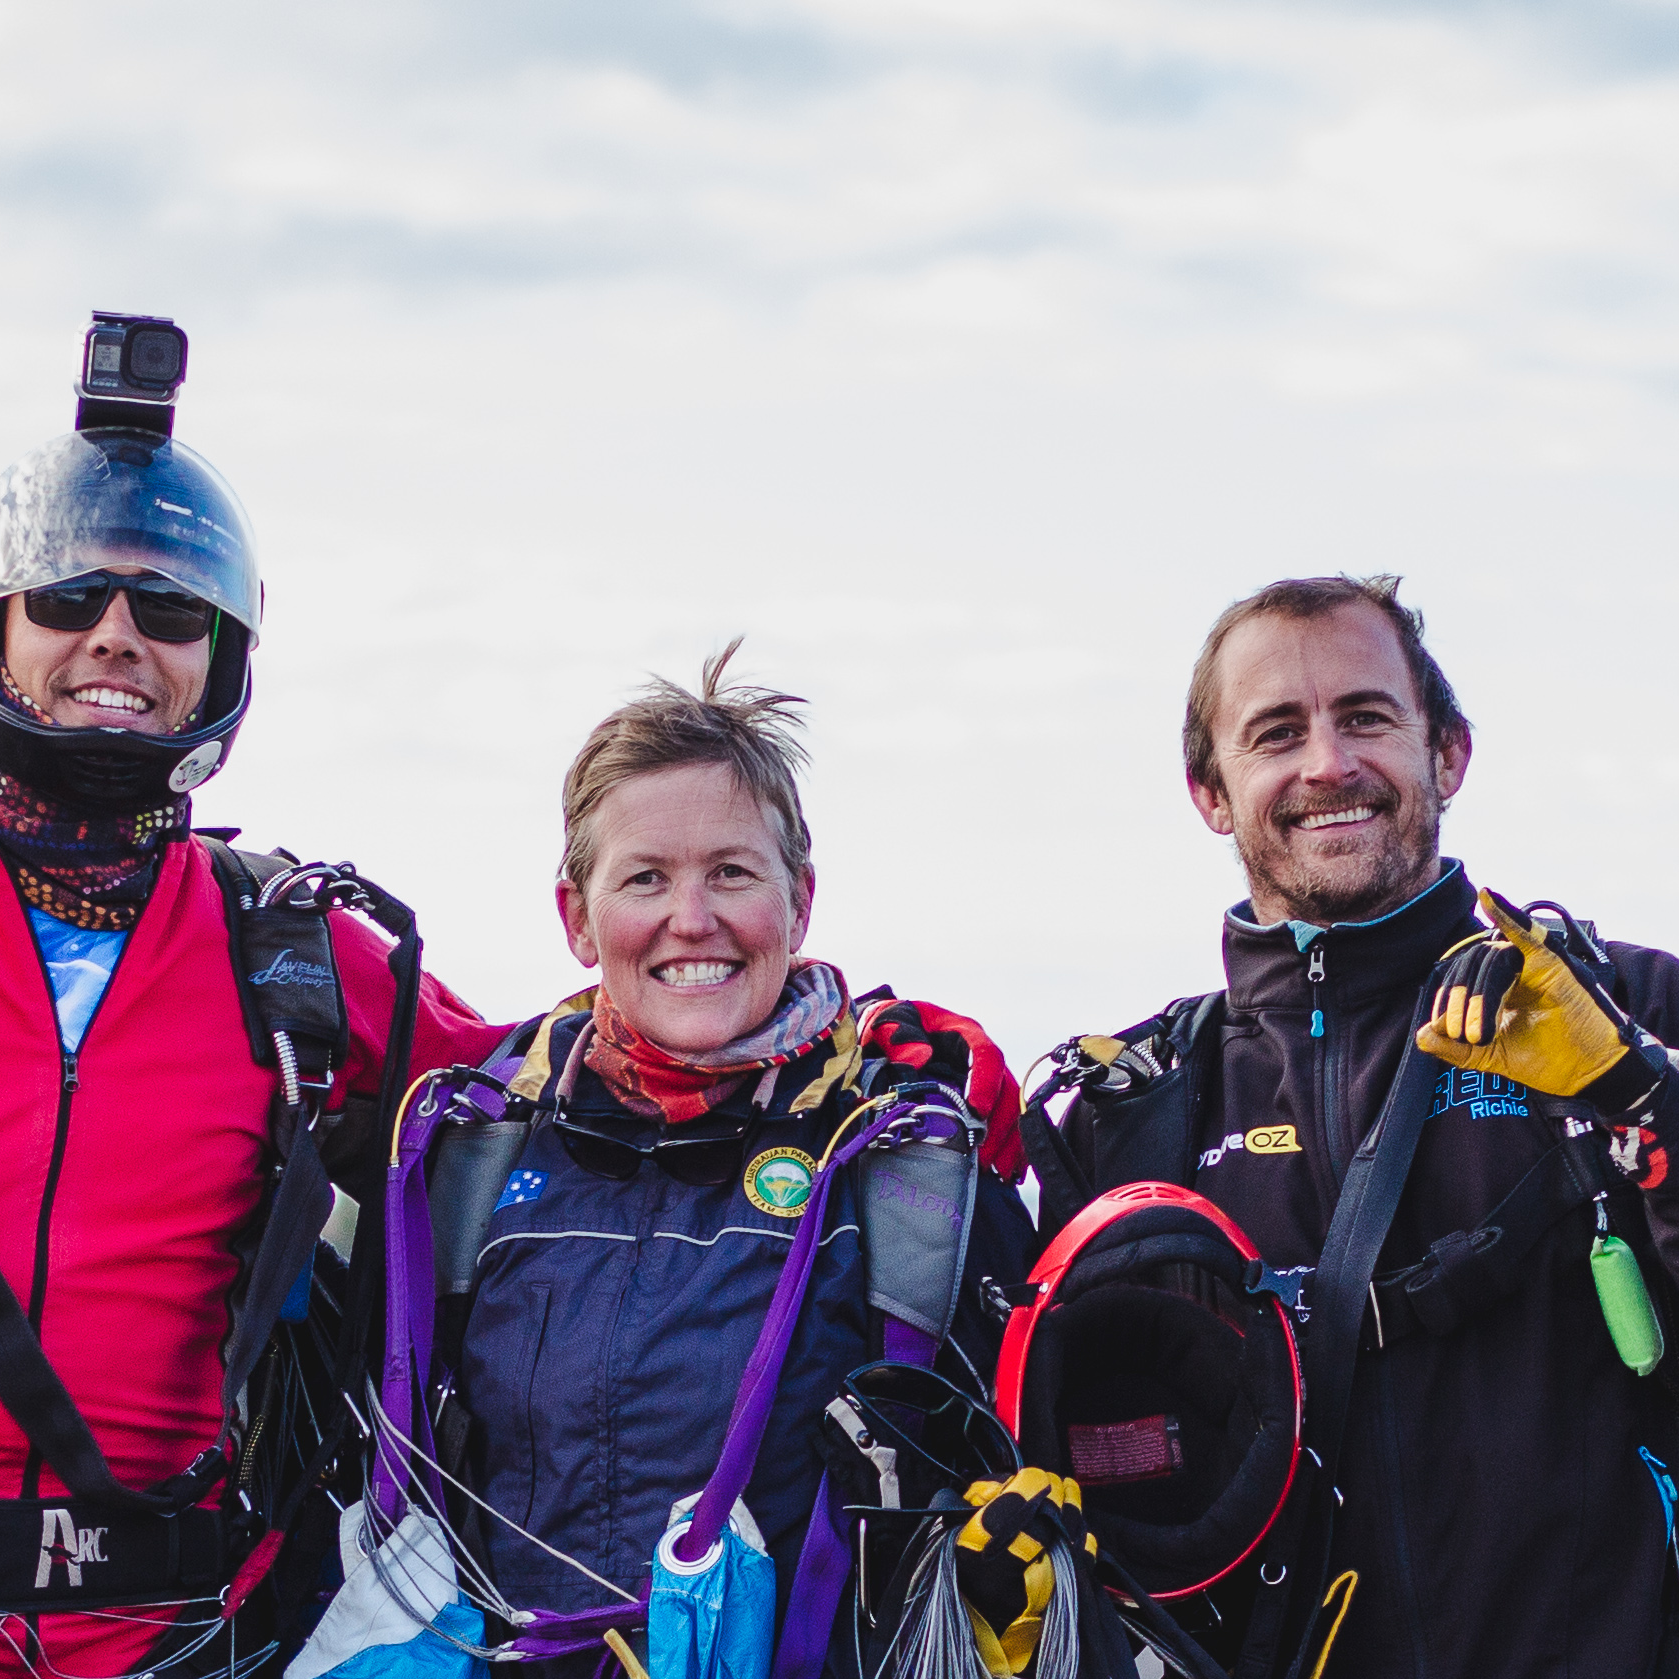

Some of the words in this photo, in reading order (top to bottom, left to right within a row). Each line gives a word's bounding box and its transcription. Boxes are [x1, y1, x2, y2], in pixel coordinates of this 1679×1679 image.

[1470, 1099, 1529, 1120] Richie
[745, 1148, 788, 1184] AUSTRALIAN
[750, 1193, 775, 1214] TEAM
